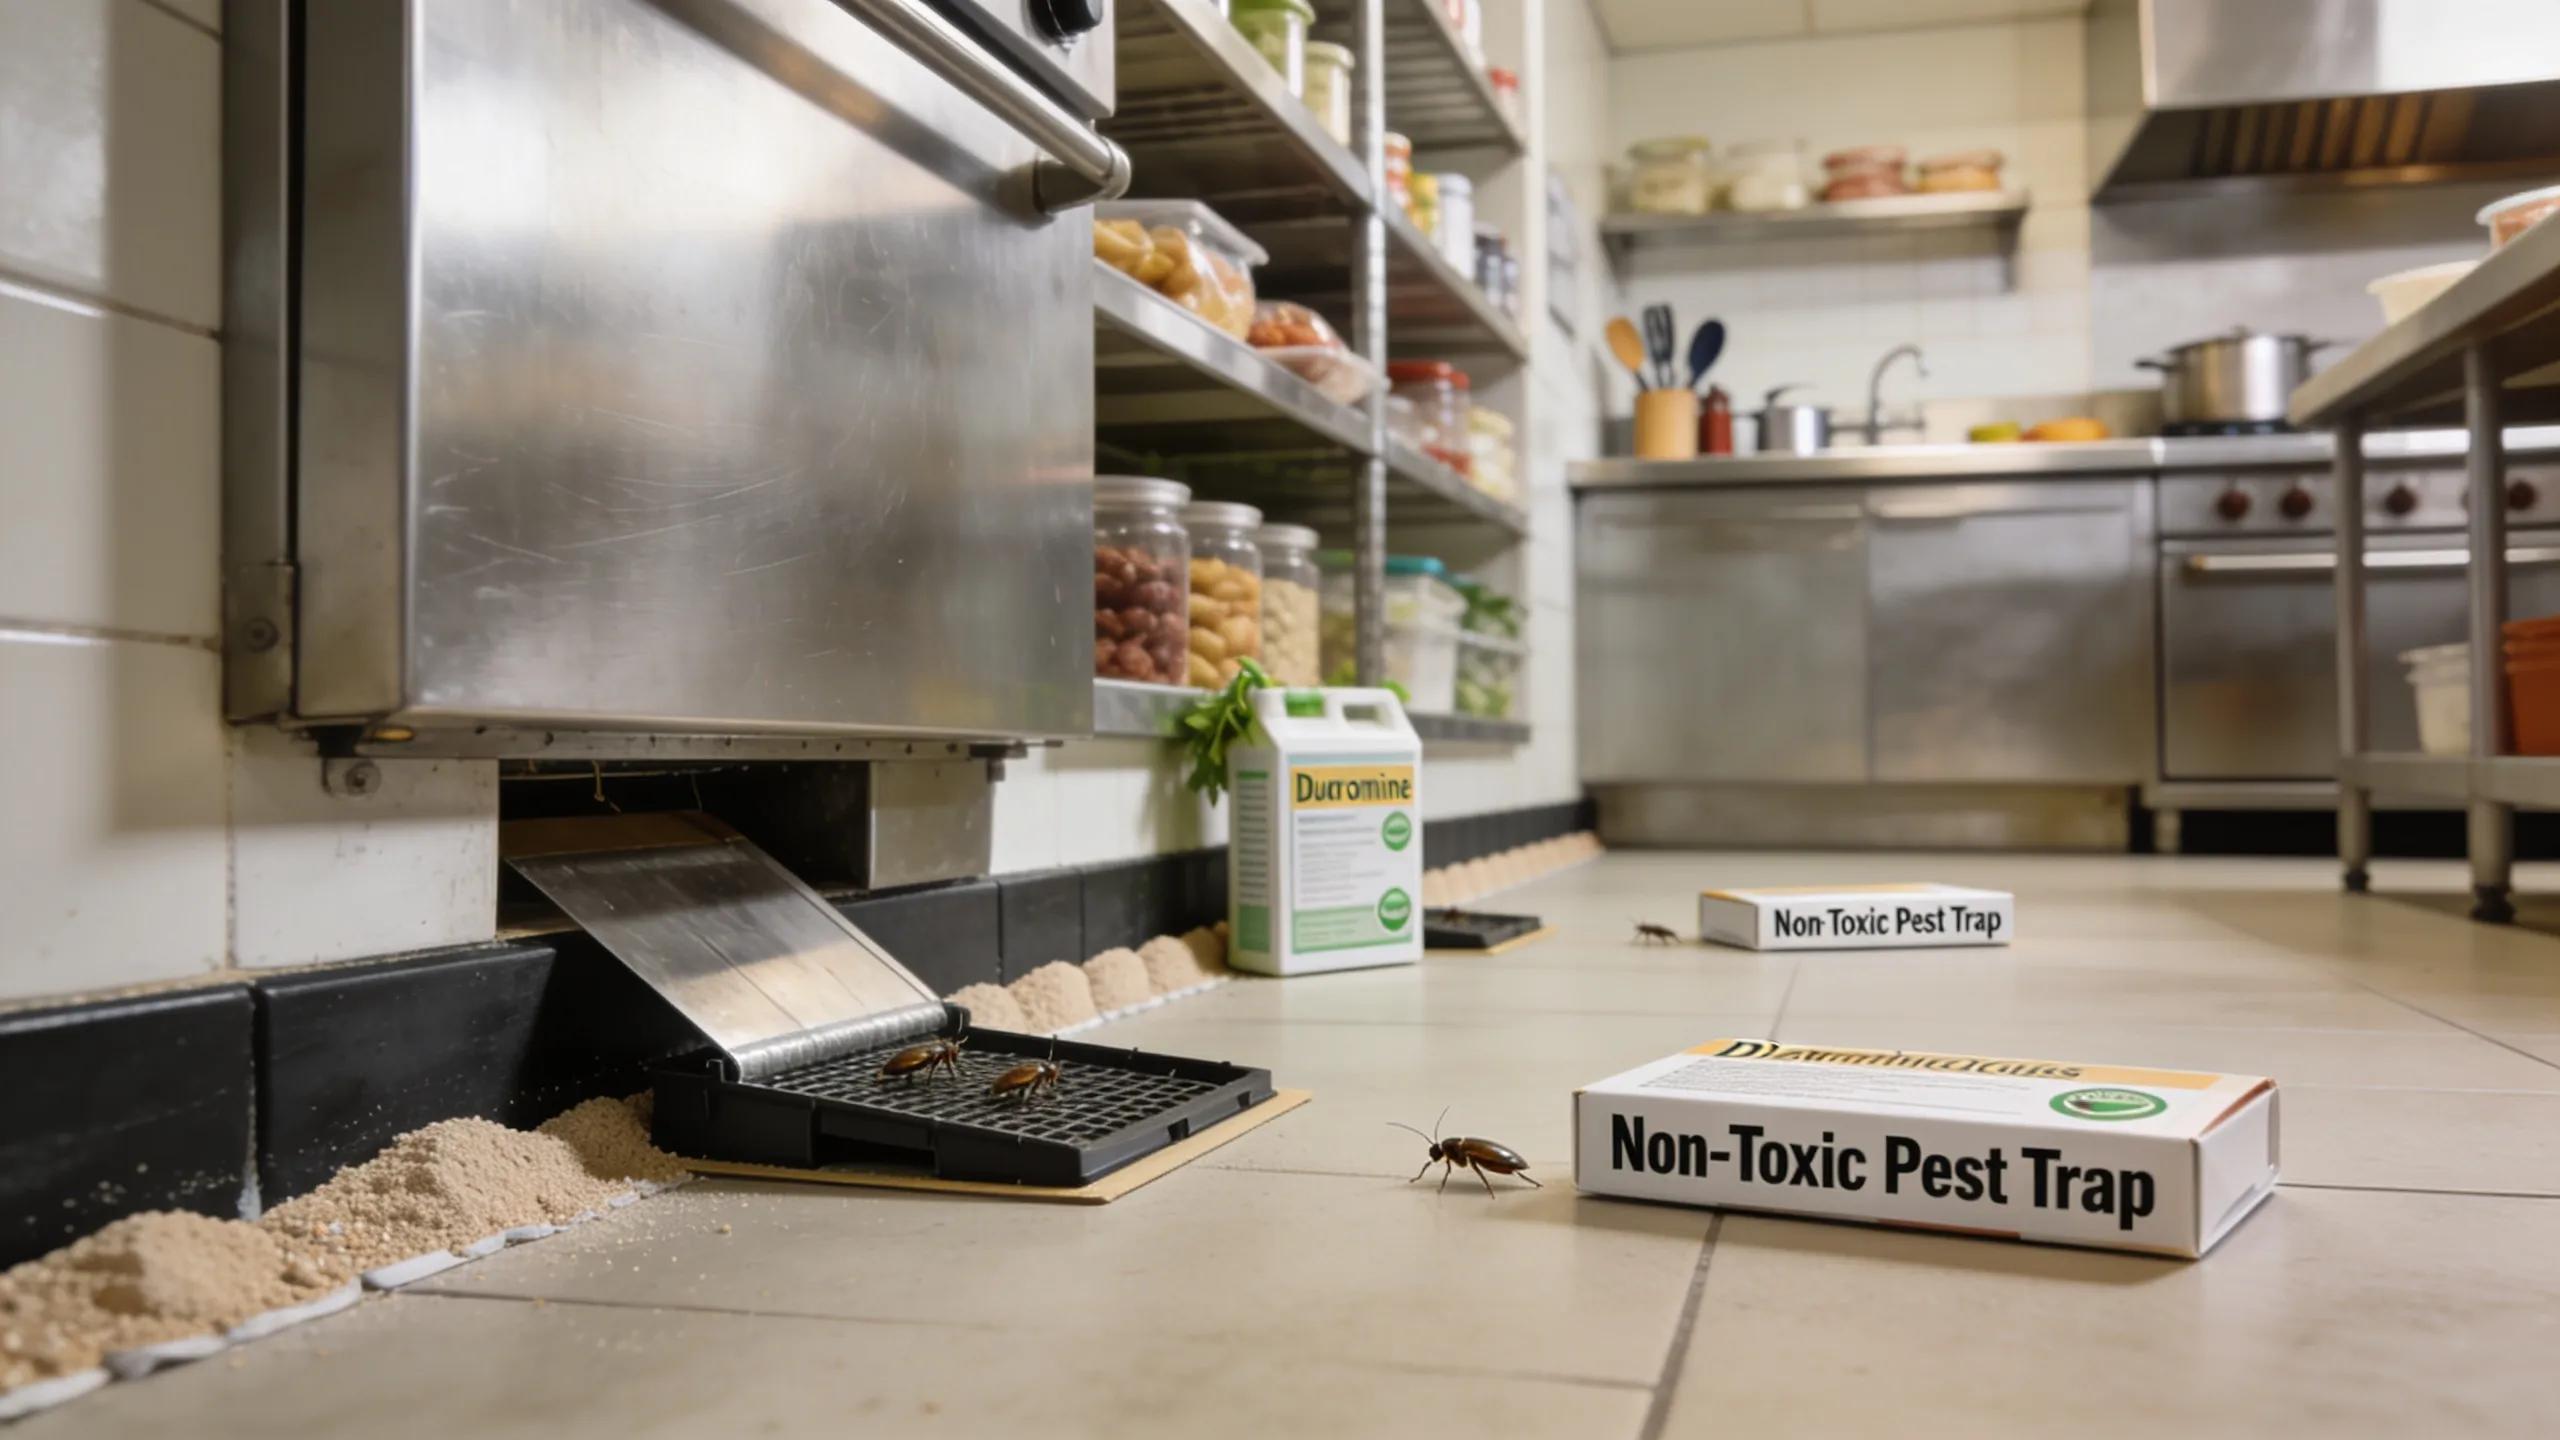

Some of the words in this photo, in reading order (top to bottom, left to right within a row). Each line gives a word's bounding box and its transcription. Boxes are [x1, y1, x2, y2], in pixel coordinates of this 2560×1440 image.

[1774, 907, 1889, 937] Non-Toxic
[1896, 907, 1945, 935] Pest
[1950, 906, 2002, 939] Trap
[1611, 1113, 1867, 1192] Non-Toxic
[1885, 1135, 2009, 1204] Pest
[2021, 1146, 2155, 1231] Trap
